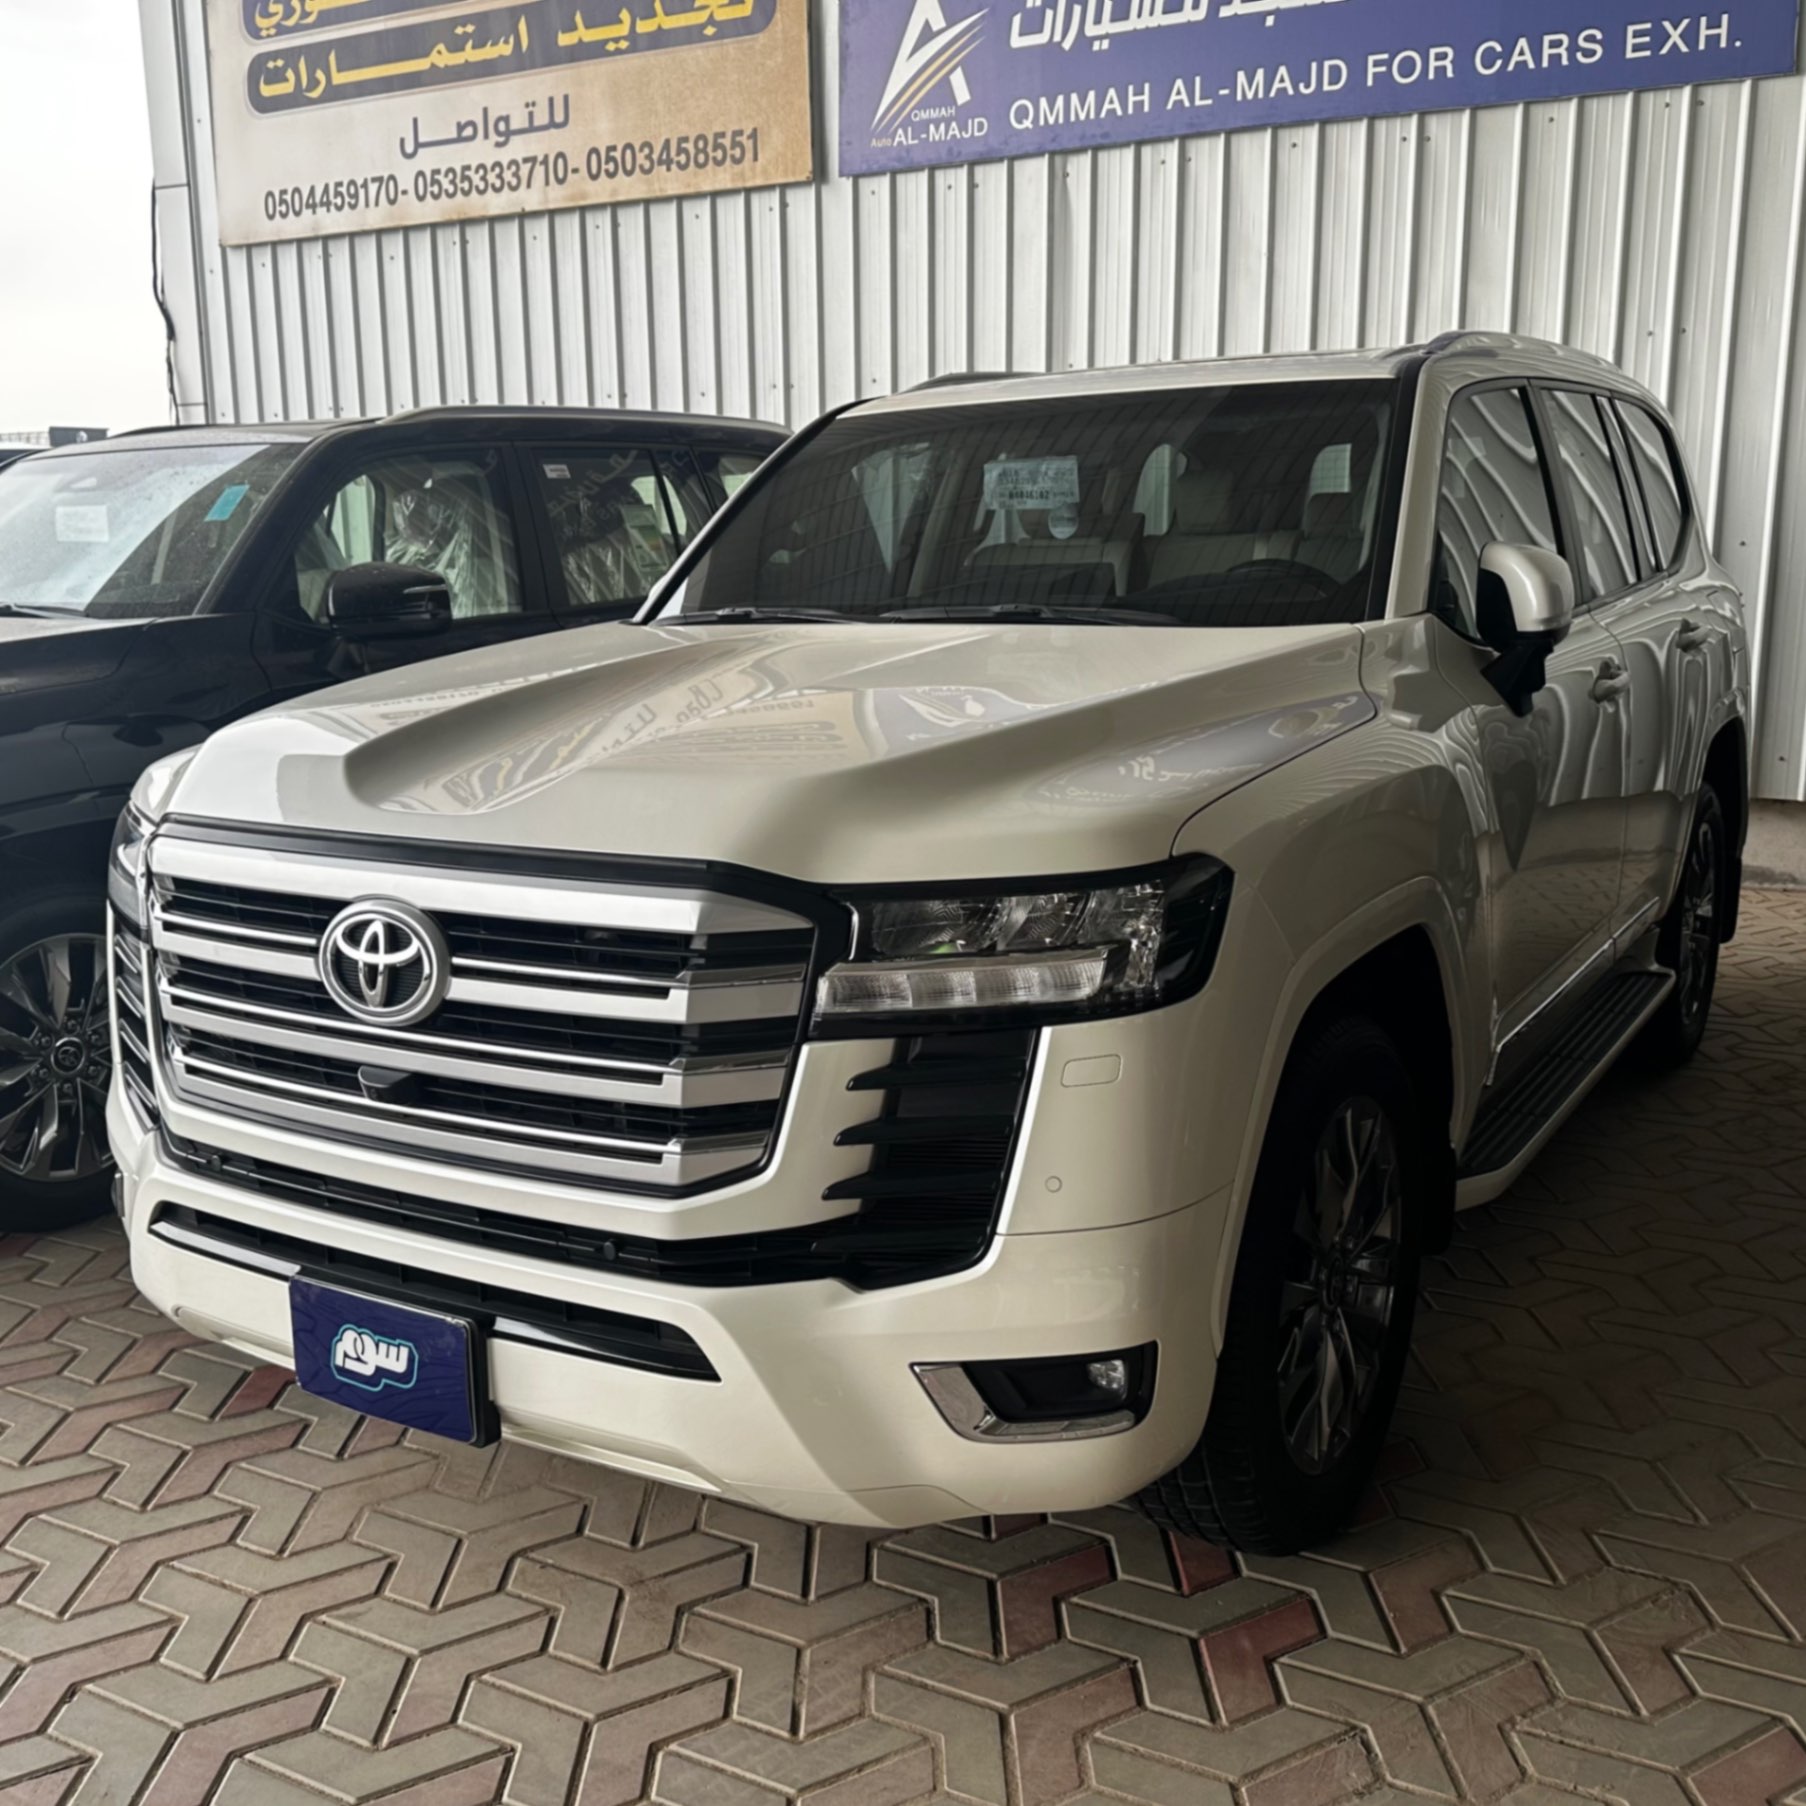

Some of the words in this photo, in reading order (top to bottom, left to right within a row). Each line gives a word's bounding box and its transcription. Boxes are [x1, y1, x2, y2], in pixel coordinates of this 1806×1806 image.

[259, 14, 530, 99] استمارات
[1009, 83, 1151, 130] QMMAH
[1166, 59, 1349, 109] AL-MAJD
[1365, 46, 1455, 87] FOR
[1474, 29, 1605, 75] CARS
[1624, 13, 1743, 59] EXH.
[400, 94, 570, 159] للتواصل
[893, 116, 989, 147] AL-MAJD
[911, 105, 956, 122] QMMAH
[586, 127, 759, 181] 0503458551
